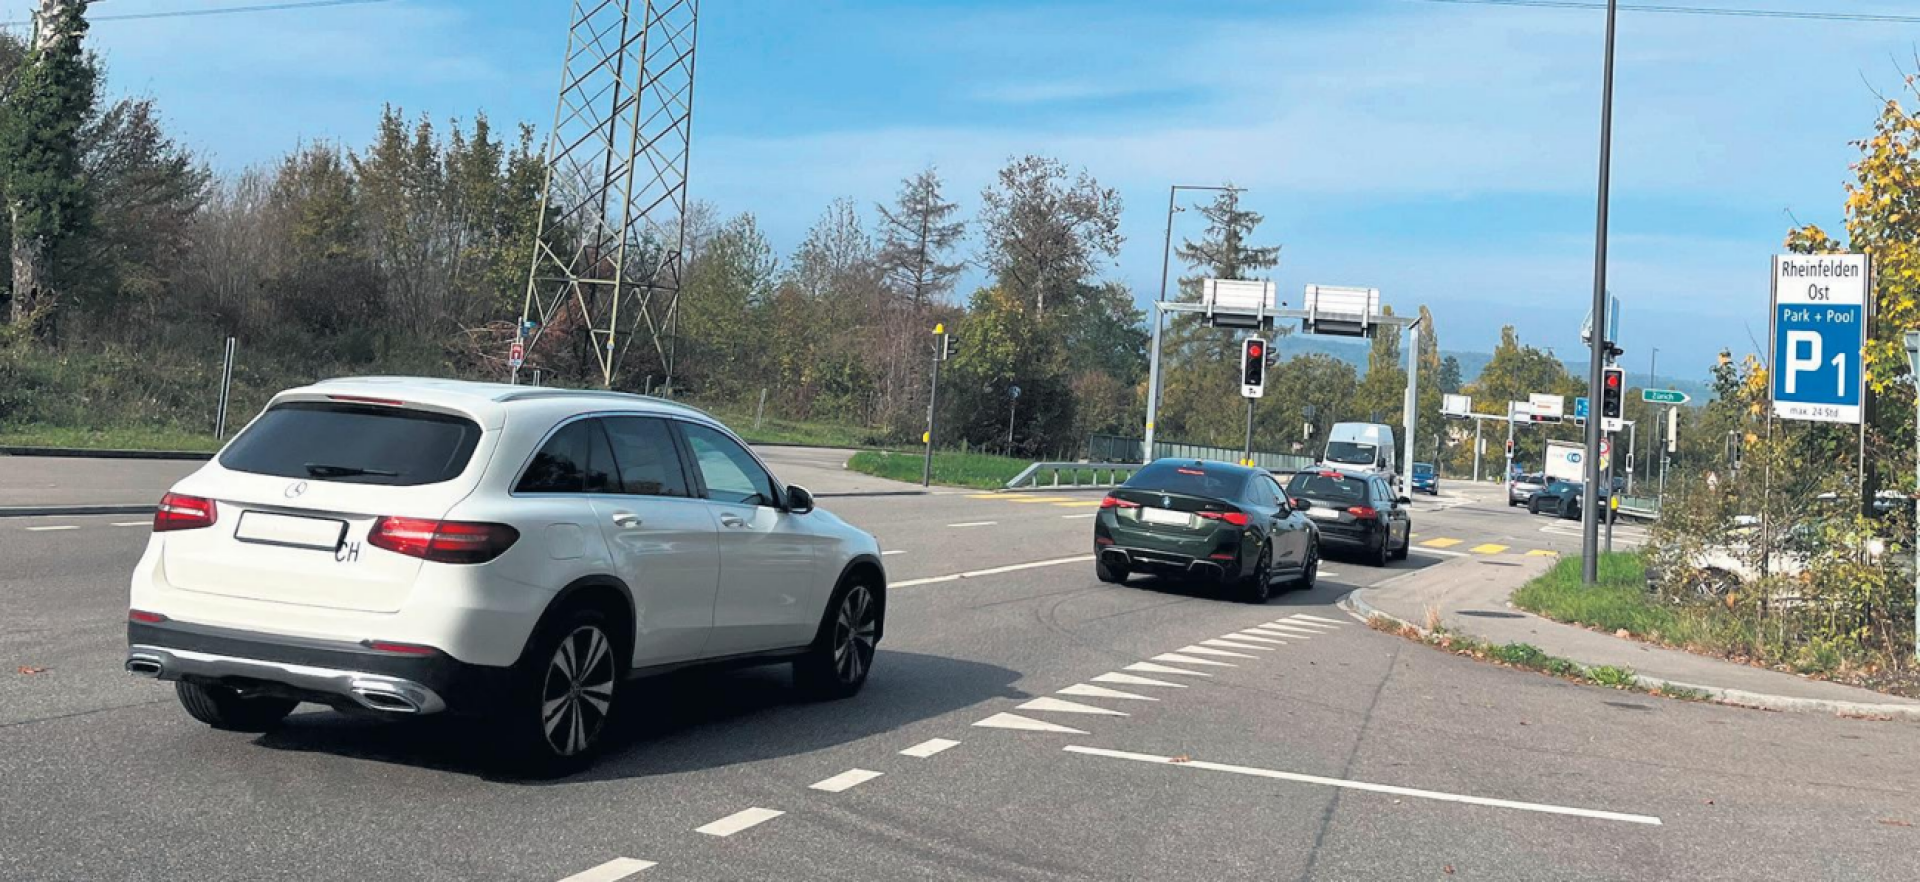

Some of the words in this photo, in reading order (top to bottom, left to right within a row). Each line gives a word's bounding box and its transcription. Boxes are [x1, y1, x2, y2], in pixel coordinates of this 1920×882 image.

[1782, 260, 1859, 278] Rheinfelden
[1808, 283, 1830, 301] Ost
[1783, 309, 1810, 322] Park
[1826, 309, 1854, 323] Pool
[1784, 330, 1822, 394] P
[1831, 353, 1846, 397] 1
[1811, 407, 1822, 416] 24
[335, 541, 361, 562] CH
